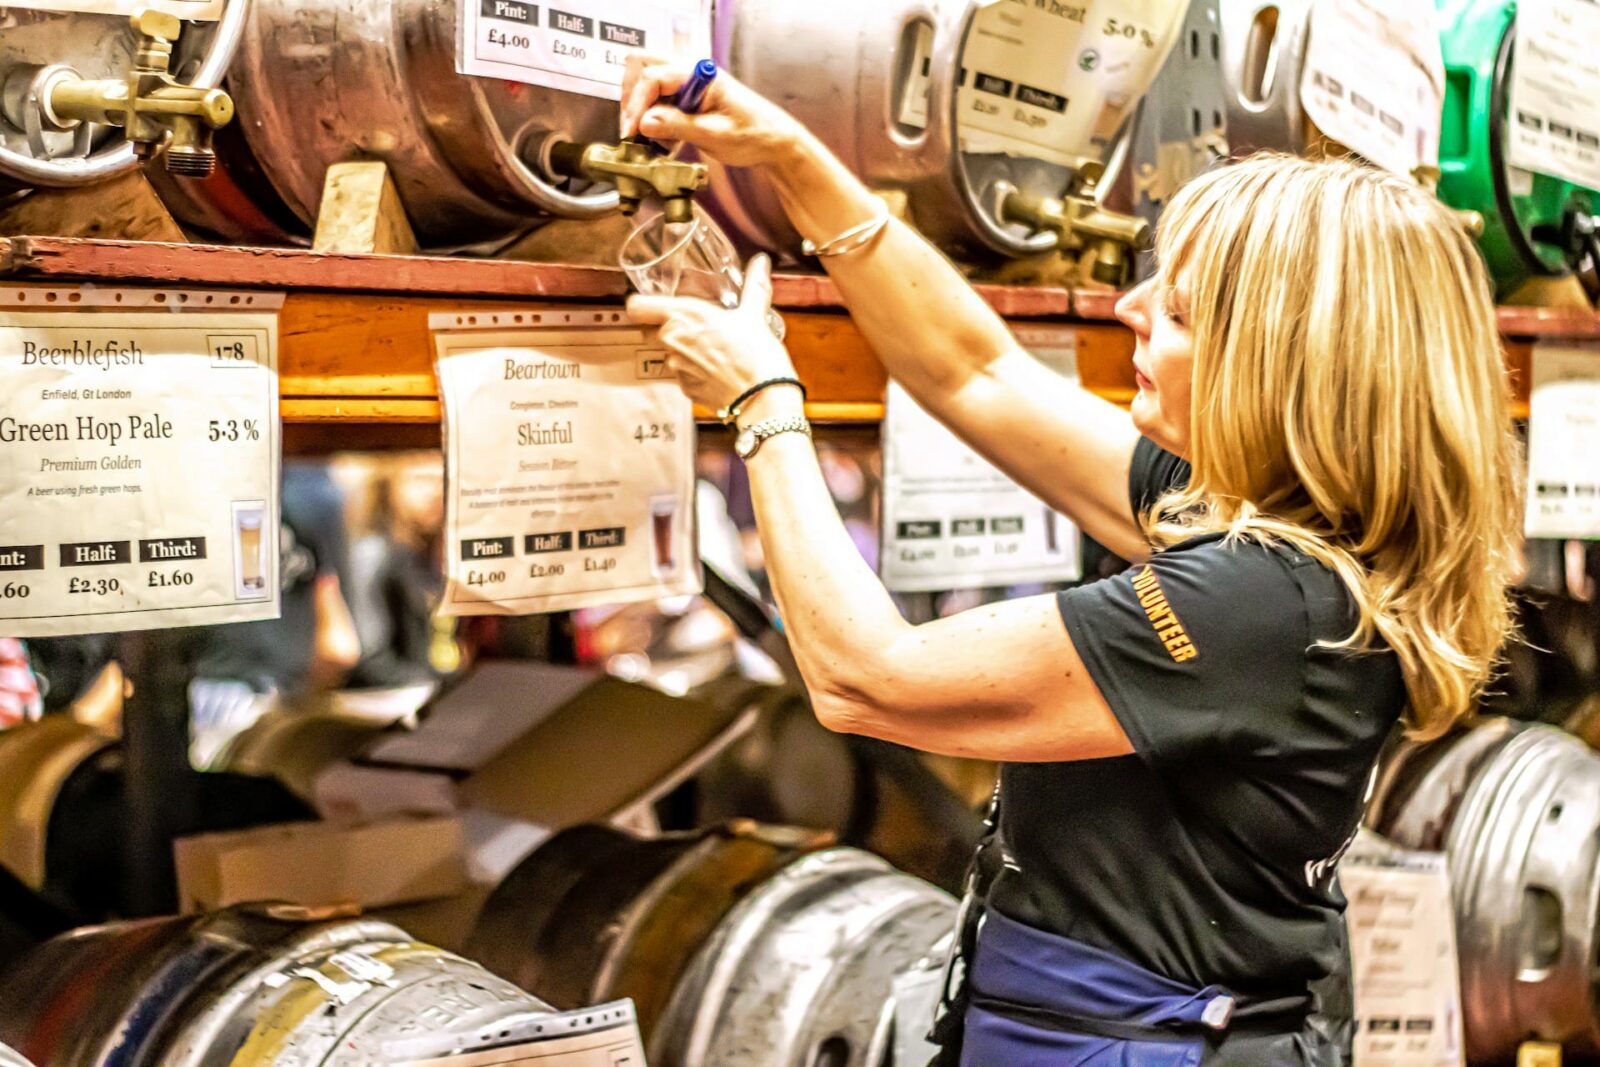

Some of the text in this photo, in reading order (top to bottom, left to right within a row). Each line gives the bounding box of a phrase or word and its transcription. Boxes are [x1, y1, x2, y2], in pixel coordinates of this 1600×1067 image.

[495, 0, 639, 46] Pint: Half: Third:
[488, 28, 530, 49] £4.00
[553, 39, 586, 60] £2.00
[22, 340, 144, 371] Beerblefish
[215, 342, 244, 365] 178
[504, 358, 581, 380] Beartown
[643, 360, 665, 377] 17
[42, 389, 132, 400] Enfield, Gt London
[0, 413, 173, 446] Green Hop Pale
[517, 421, 573, 446] Skinful
[40, 455, 142, 472] Premium Golden
[27, 487, 34, 496] A
[35, 486, 55, 496] beer
[55, 486, 77, 497] using
[77, 485, 98, 498] fresh
[99, 485, 121, 496] green
[0, 540, 197, 566] nt: Half: Third:
[472, 531, 618, 557] Pint: Half: Third:
[68, 577, 119, 596] £2.30
[148, 570, 194, 587] £1.60
[467, 557, 616, 586] £4.00 £2.00 £1.40
[1131, 564, 1198, 663] VOLUNTEER
